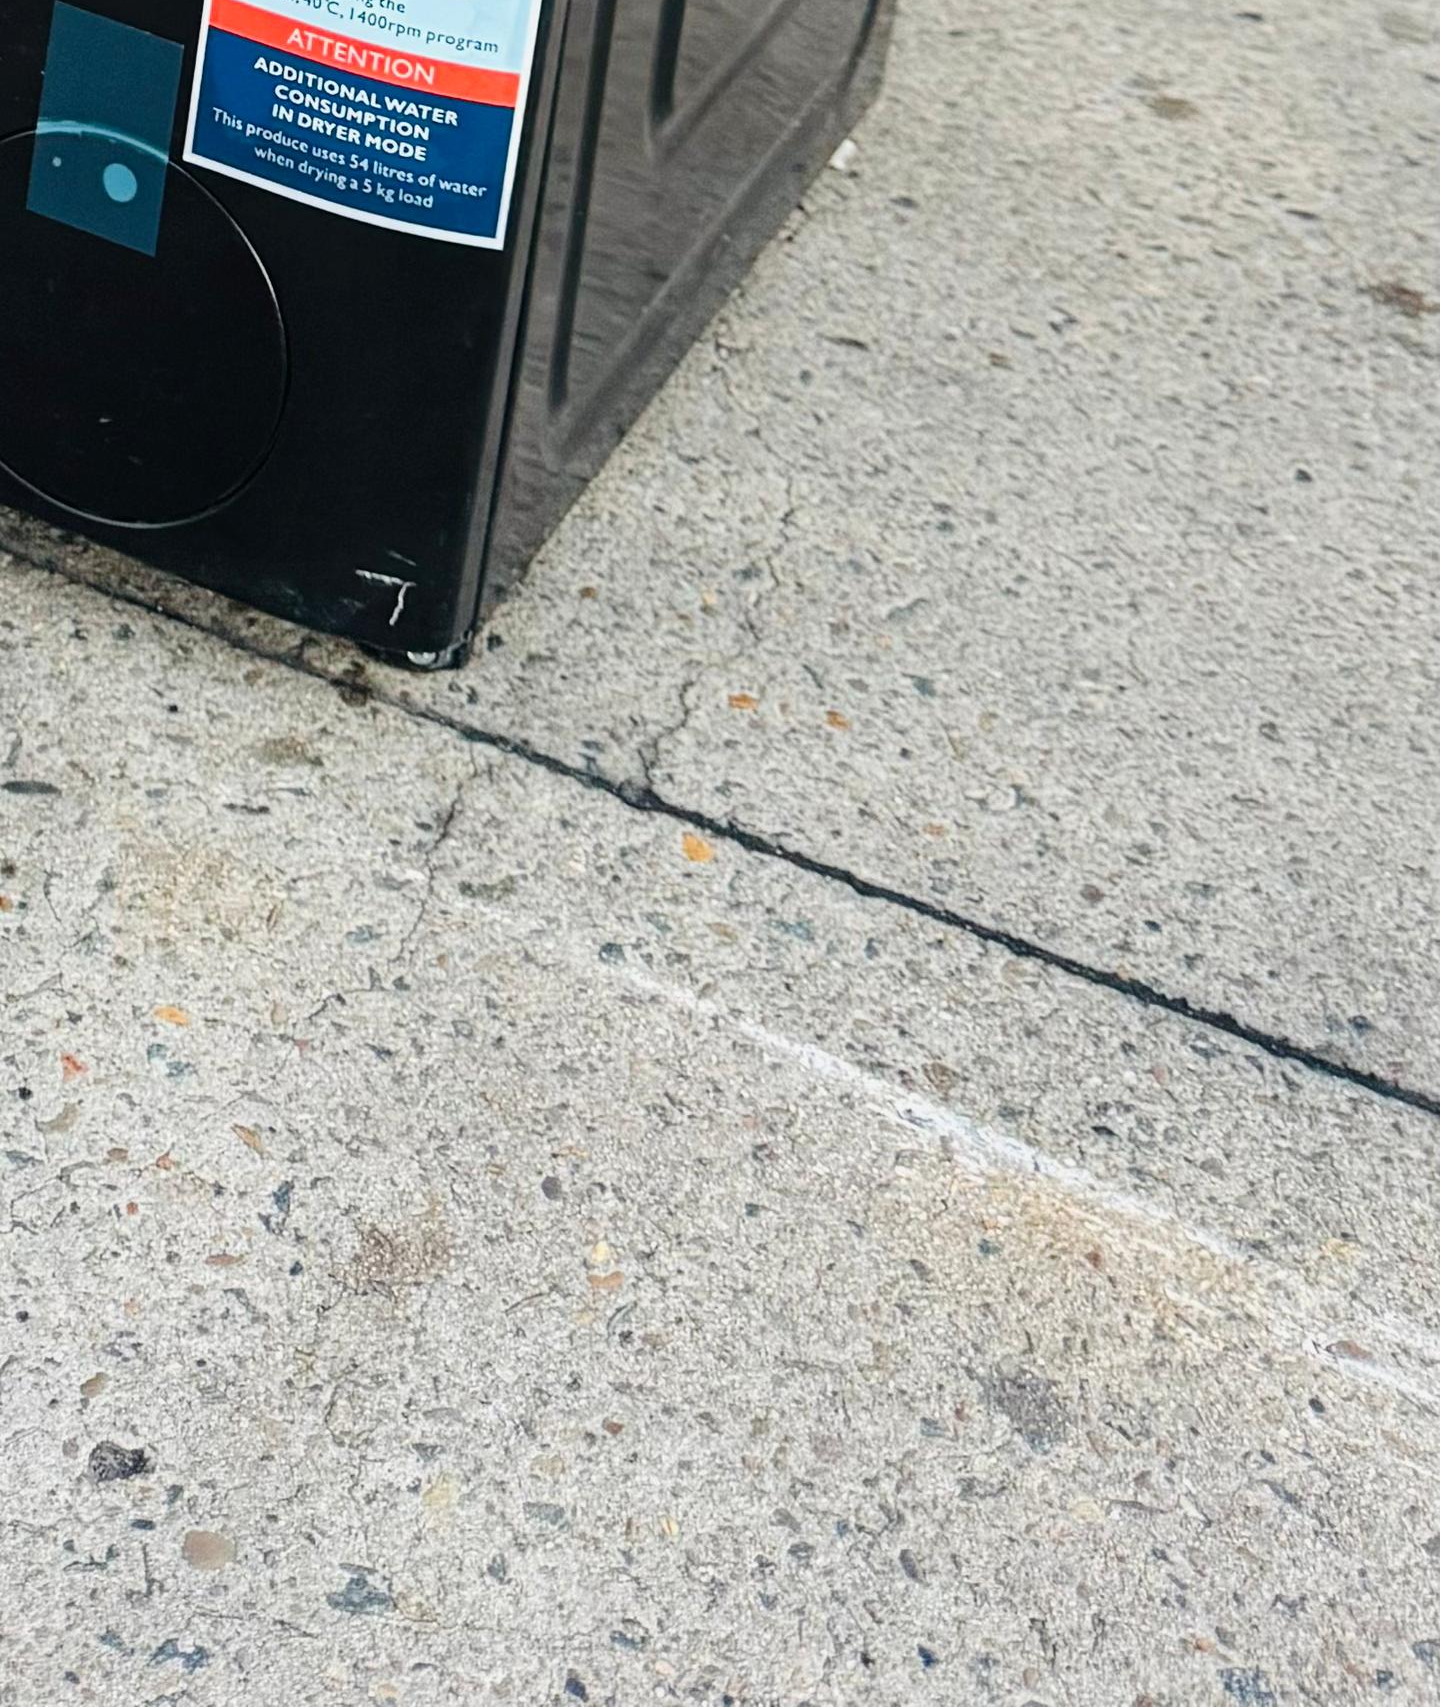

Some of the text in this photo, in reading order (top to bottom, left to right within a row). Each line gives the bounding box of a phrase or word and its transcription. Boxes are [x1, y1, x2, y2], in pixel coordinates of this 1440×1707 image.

[286, 28, 436, 85] ATTENTION
[348, 7, 422, 39] 1400rpm
[425, 30, 500, 54] program
[253, 57, 459, 127] ADDITIONAL WATER
[274, 85, 430, 141] CONSUMPTION
[212, 107, 488, 198] This produce uses 54 litres of water
[272, 103, 428, 162] IN DRYER MODE
[253, 145, 434, 209] when drying a 5 kg load
